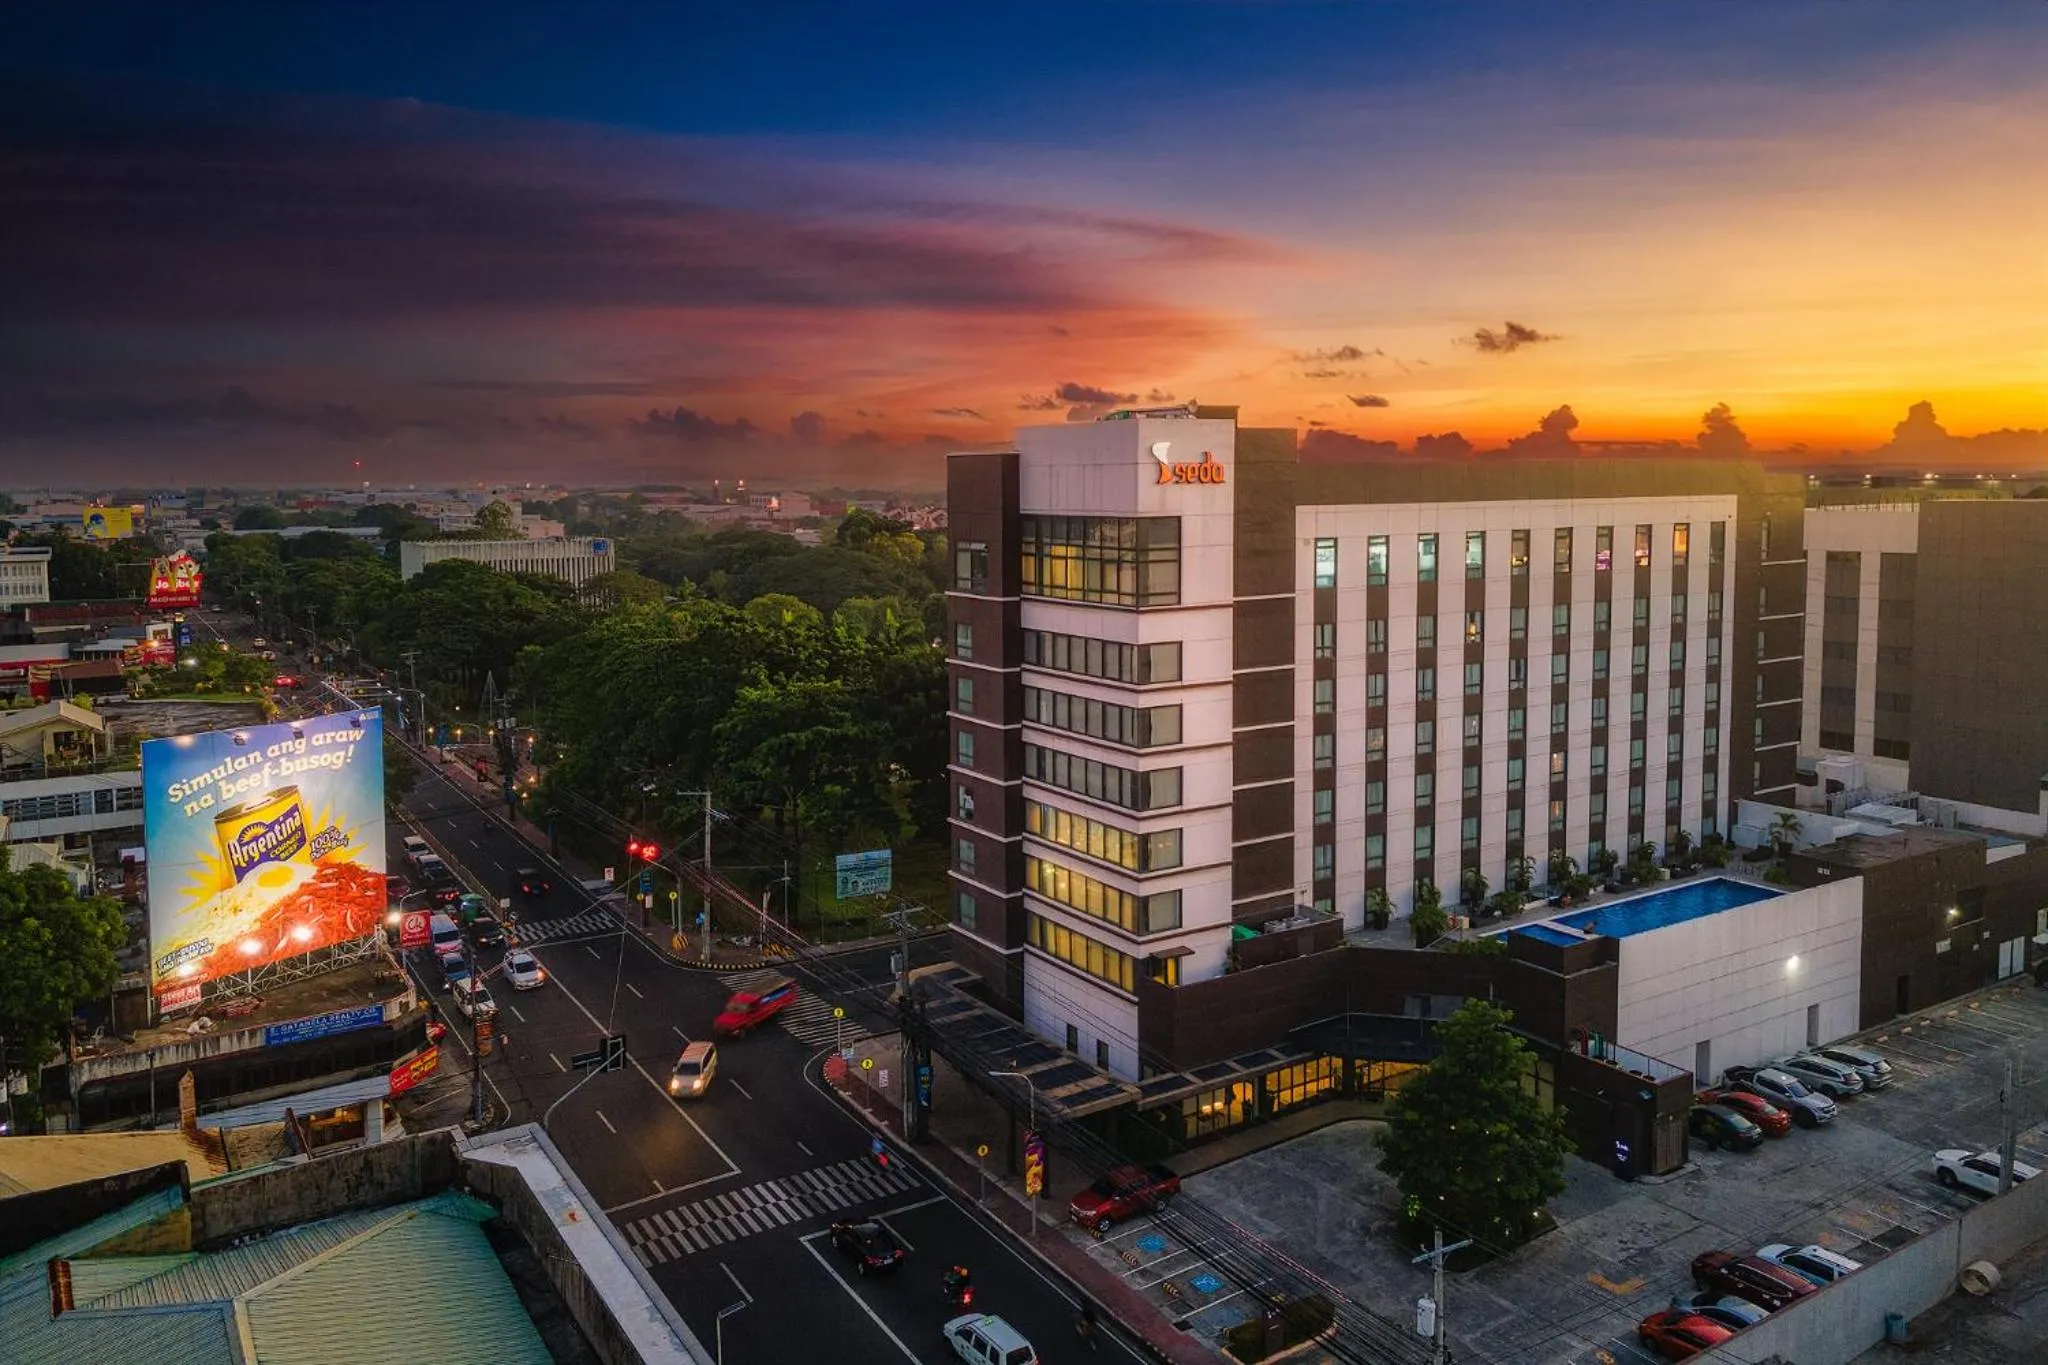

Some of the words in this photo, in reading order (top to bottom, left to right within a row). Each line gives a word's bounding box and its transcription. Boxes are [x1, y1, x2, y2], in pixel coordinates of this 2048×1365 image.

[1174, 449, 1225, 484] seda
[168, 751, 263, 803] Simulan
[267, 737, 306, 756] ang
[311, 728, 365, 746] araw
[183, 792, 215, 817] na
[219, 745, 354, 798] beef-busog!
[229, 811, 301, 867] Argentina
